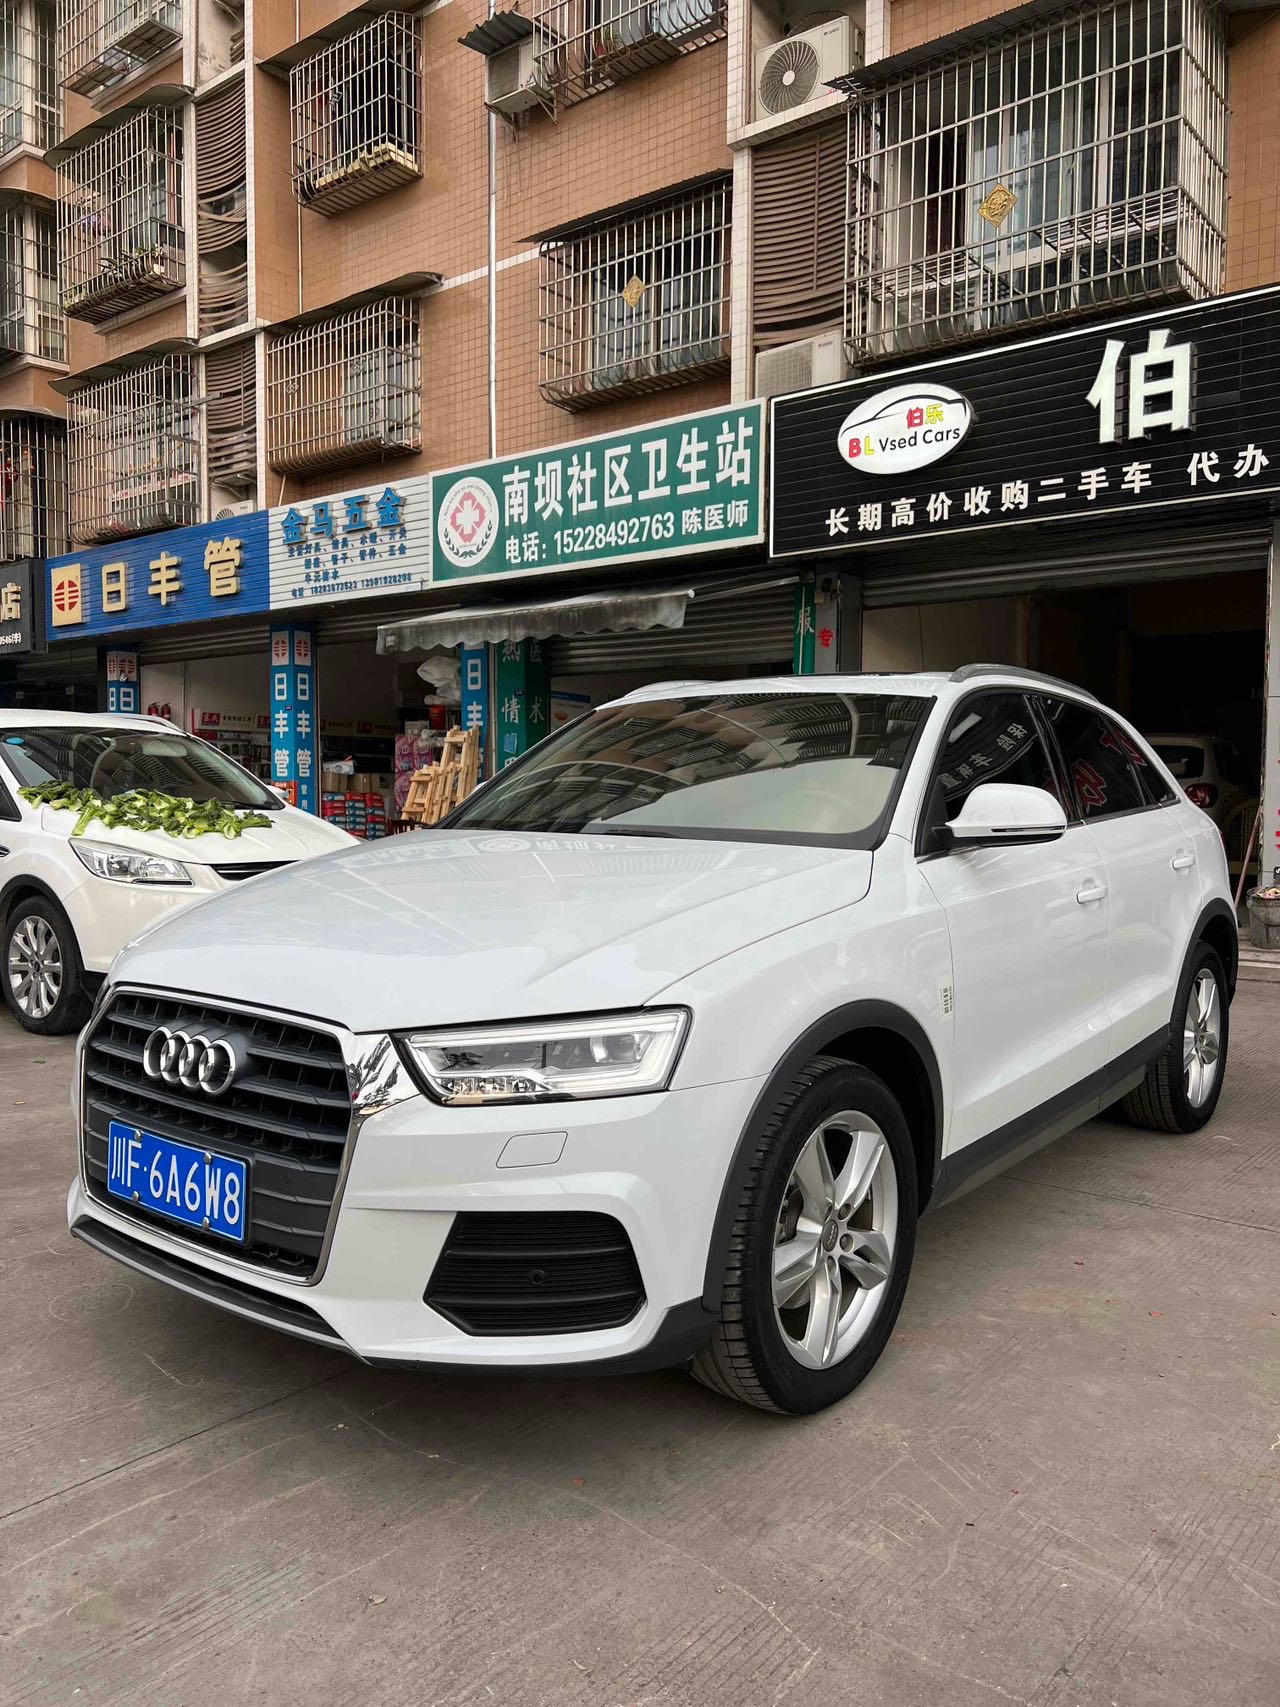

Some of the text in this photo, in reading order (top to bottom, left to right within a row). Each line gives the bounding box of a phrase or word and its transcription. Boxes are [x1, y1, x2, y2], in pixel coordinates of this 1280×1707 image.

[906, 403, 944, 429] 伯乐
[1087, 329, 1198, 445] 伯
[502, 416, 753, 526] 南坝社区卫生站
[879, 431, 918, 453] Vsed
[922, 427, 960, 444] Cars
[280, 487, 406, 545] 金马五金
[554, 511, 675, 555] 15228492763
[682, 500, 749, 536] 陈医师
[825, 443, 1269, 536] 长期高价收购二手车 代办
[102, 537, 243, 614] 日丰管
[274, 673, 289, 777] 日丰管
[296, 673, 311, 777] 日丰管
